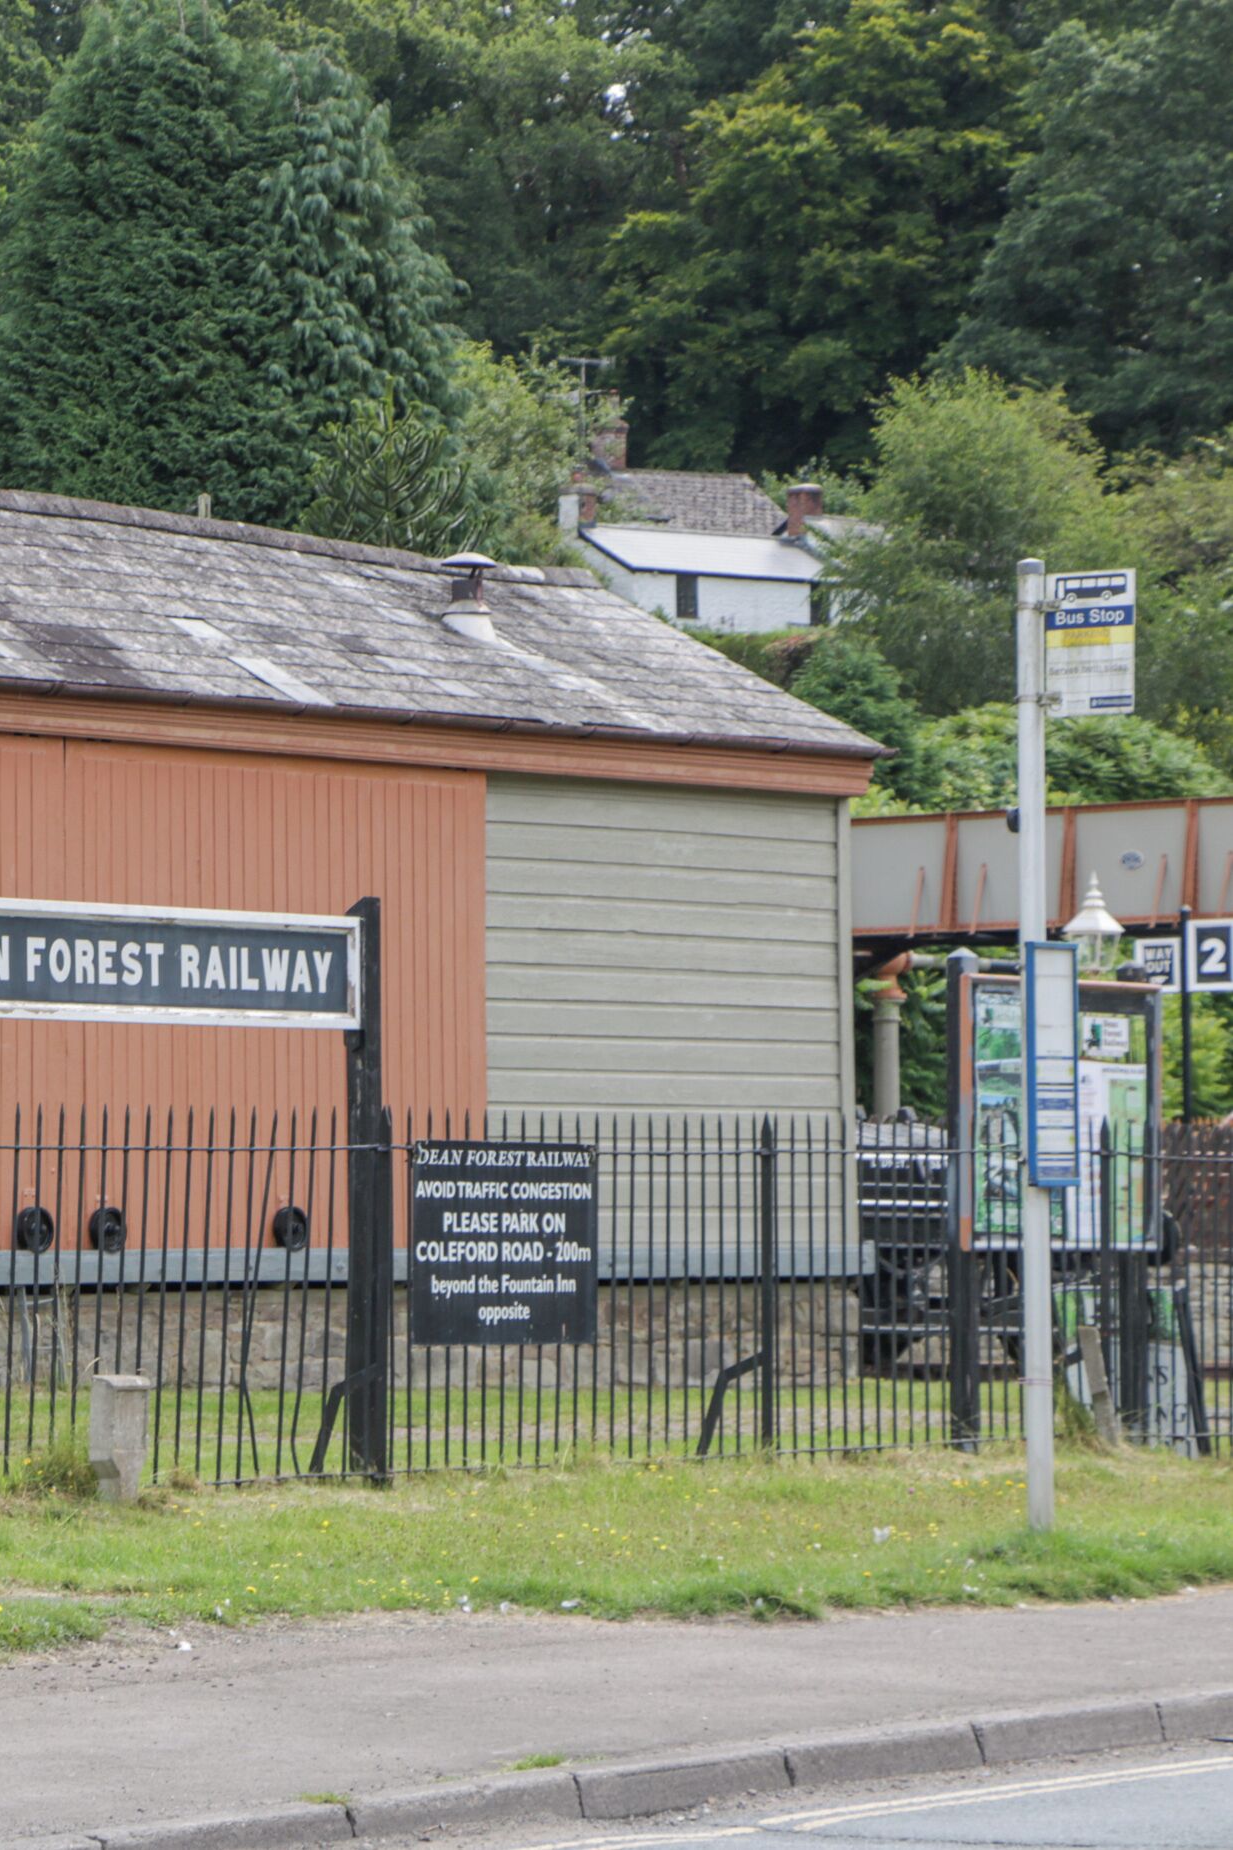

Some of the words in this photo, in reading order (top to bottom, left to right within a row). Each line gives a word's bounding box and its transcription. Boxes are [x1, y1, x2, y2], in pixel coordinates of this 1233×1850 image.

[1055, 610, 1085, 625] Bus
[1089, 608, 1125, 624] Stop
[1145, 947, 1172, 960] WAY
[1200, 937, 1226, 974] 2
[26, 937, 164, 986] FOREST
[180, 943, 333, 993] RAILWAY
[1146, 961, 1171, 973] OUT
[416, 1148, 463, 1166] DEAN
[465, 1150, 526, 1167] FOREST
[526, 1151, 592, 1168] RAILWAY
[416, 1181, 456, 1198] AVOID
[457, 1182, 509, 1199] TRAFFIC
[511, 1182, 592, 1200] CONGESTION
[443, 1212, 498, 1233] PLEASE
[501, 1212, 539, 1233] PARK
[542, 1213, 566, 1233] ON
[416, 1241, 497, 1262] COLEFORD
[501, 1241, 544, 1262] ROAD
[555, 1241, 591, 1262] 200m
[431, 1274, 476, 1298] beyond
[478, 1275, 499, 1293] the
[501, 1275, 554, 1293] Fountain
[557, 1274, 576, 1293] Inn
[478, 1301, 531, 1326] opposite
